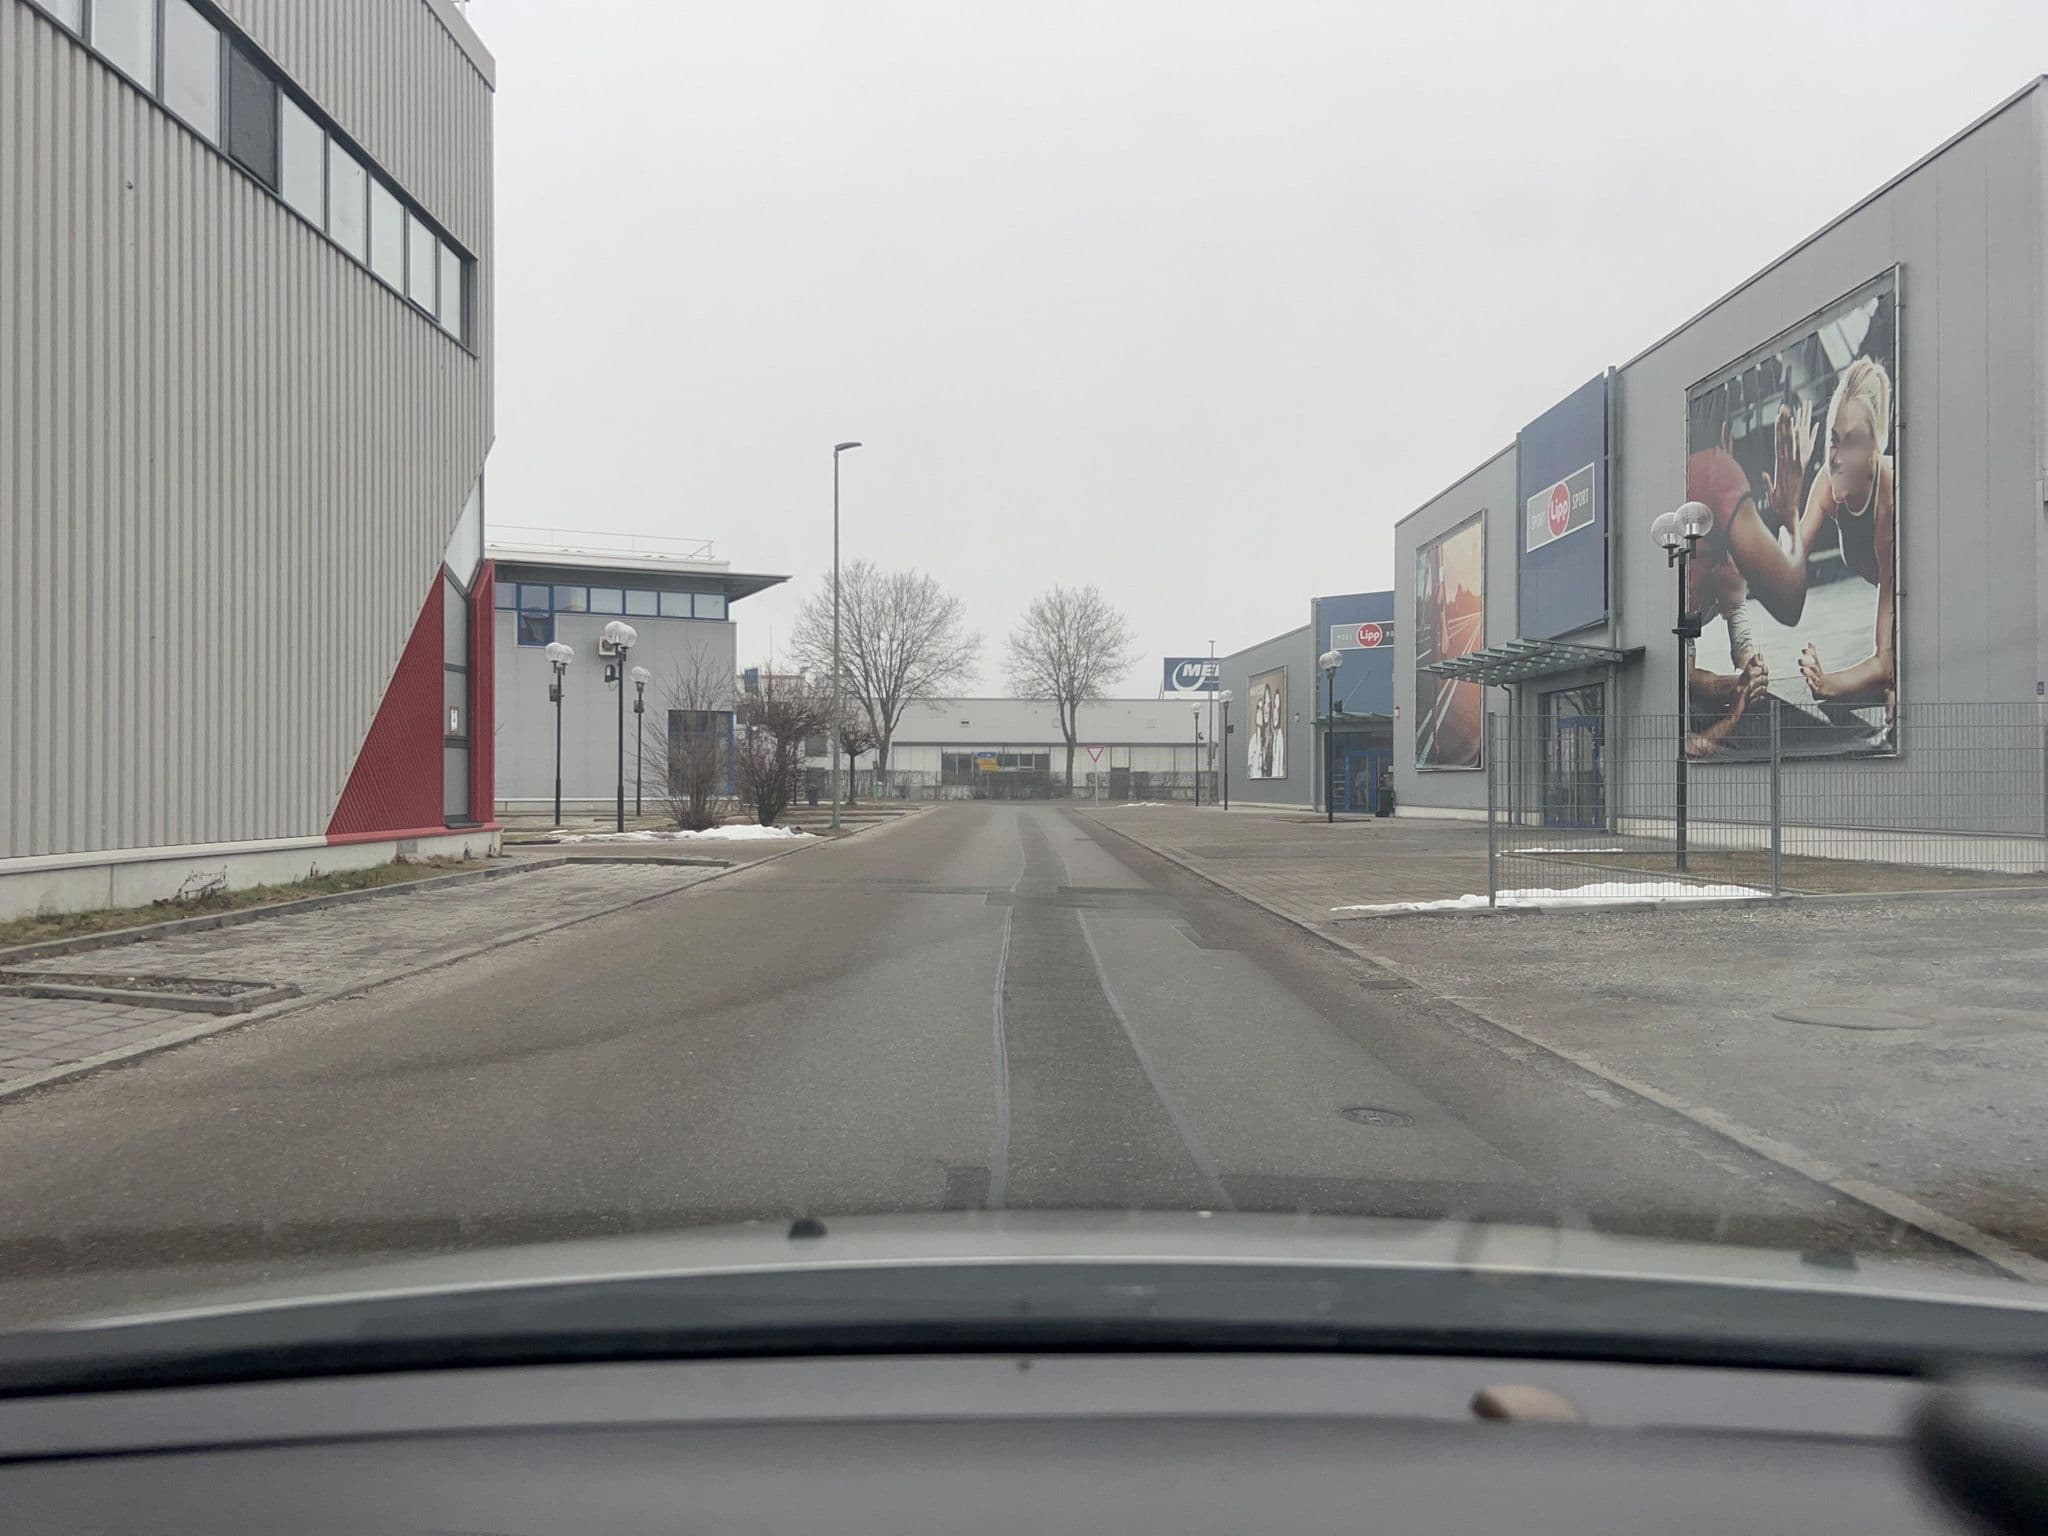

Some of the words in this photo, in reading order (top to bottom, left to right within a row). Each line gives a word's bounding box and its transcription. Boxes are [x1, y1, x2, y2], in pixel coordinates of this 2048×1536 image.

[1550, 498, 1568, 523] Lipp
[1572, 487, 1590, 510] SPORT
[1359, 629, 1380, 642] Lipp
